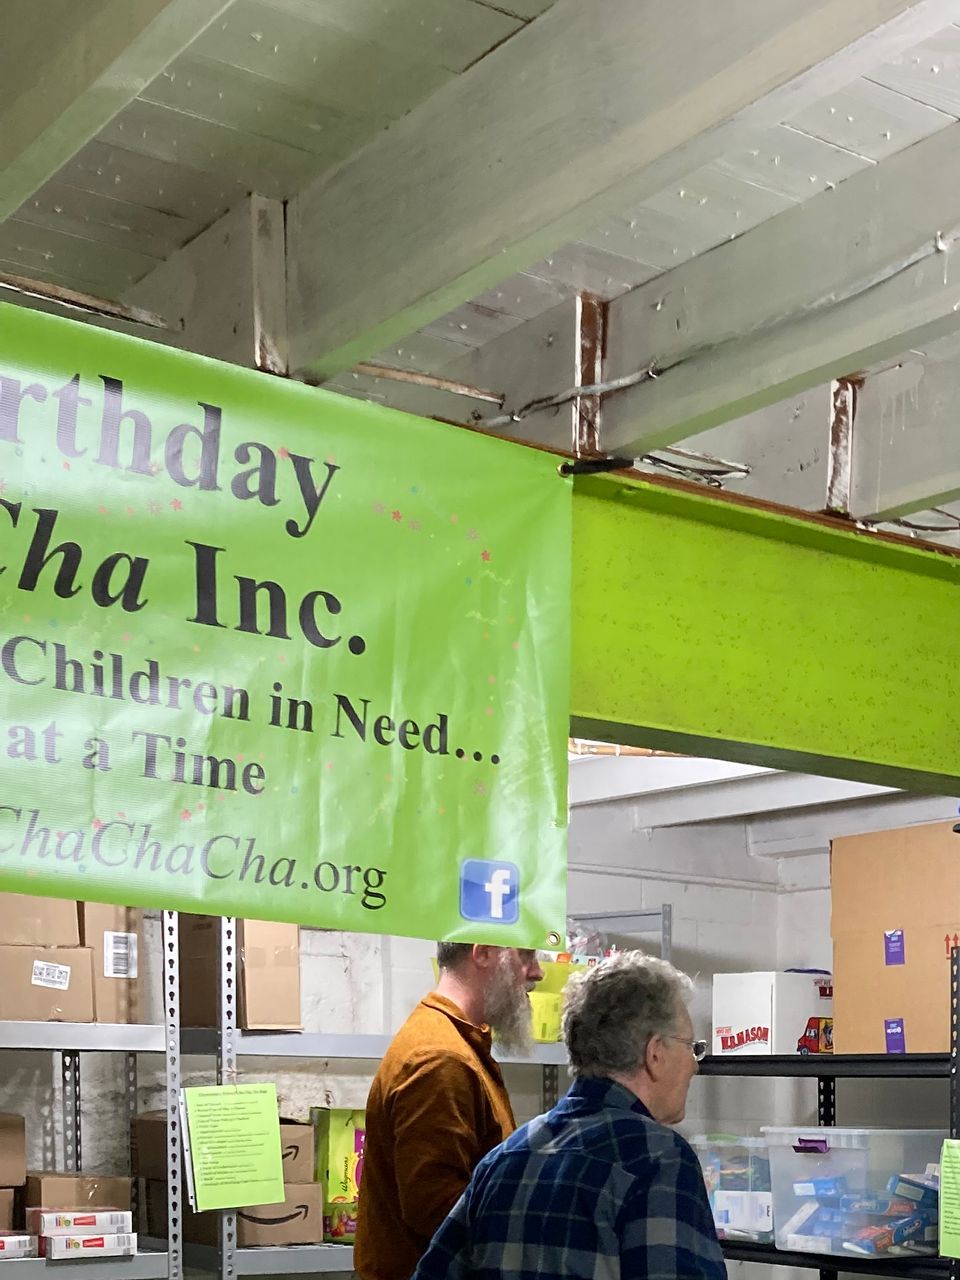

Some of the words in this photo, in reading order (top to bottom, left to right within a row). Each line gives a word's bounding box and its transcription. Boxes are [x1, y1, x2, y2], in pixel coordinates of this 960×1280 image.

[0, 372, 341, 538] rthday
[184, 539, 366, 655] Inc.
[1, 635, 251, 722] Children
[268, 681, 314, 734] in
[7, 720, 64, 764] at
[82, 737, 112, 771] a
[131, 730, 266, 796] Time
